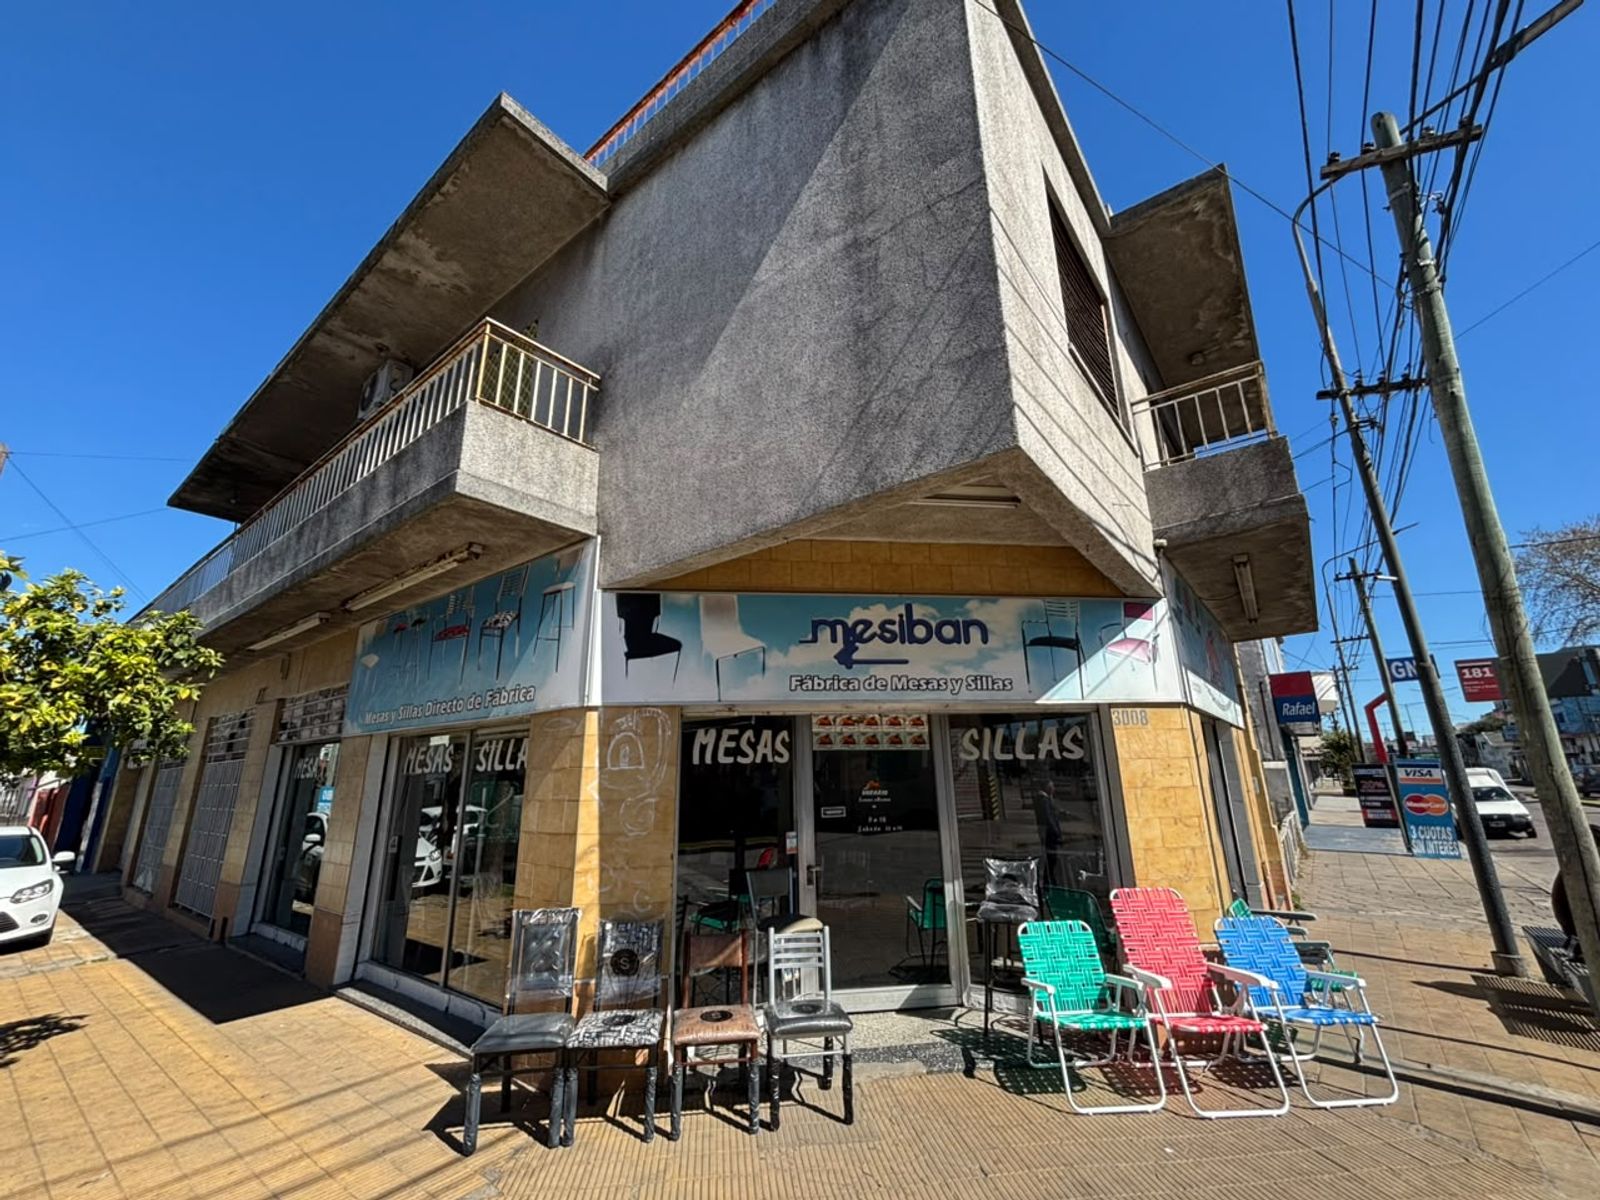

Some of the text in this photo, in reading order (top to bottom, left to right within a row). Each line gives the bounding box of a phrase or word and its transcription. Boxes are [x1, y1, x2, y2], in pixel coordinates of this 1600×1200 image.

[799, 603, 988, 650] mesiban
[1461, 667, 1494, 679] 181
[790, 675, 1013, 694] Fábrica de Mesas y Sillas
[364, 684, 537, 725] Mesas y Sillas Directo de Fábrica
[1282, 702, 1315, 716] Rafael
[1112, 710, 1149, 726] 3008
[692, 728, 790, 765] MESAS
[959, 726, 1085, 760] SILLAS
[403, 743, 455, 775] MESAS
[1404, 769, 1433, 777] VISA
[1410, 825, 1453, 840] 3 CUOTAS
[1411, 839, 1425, 853] SIN
